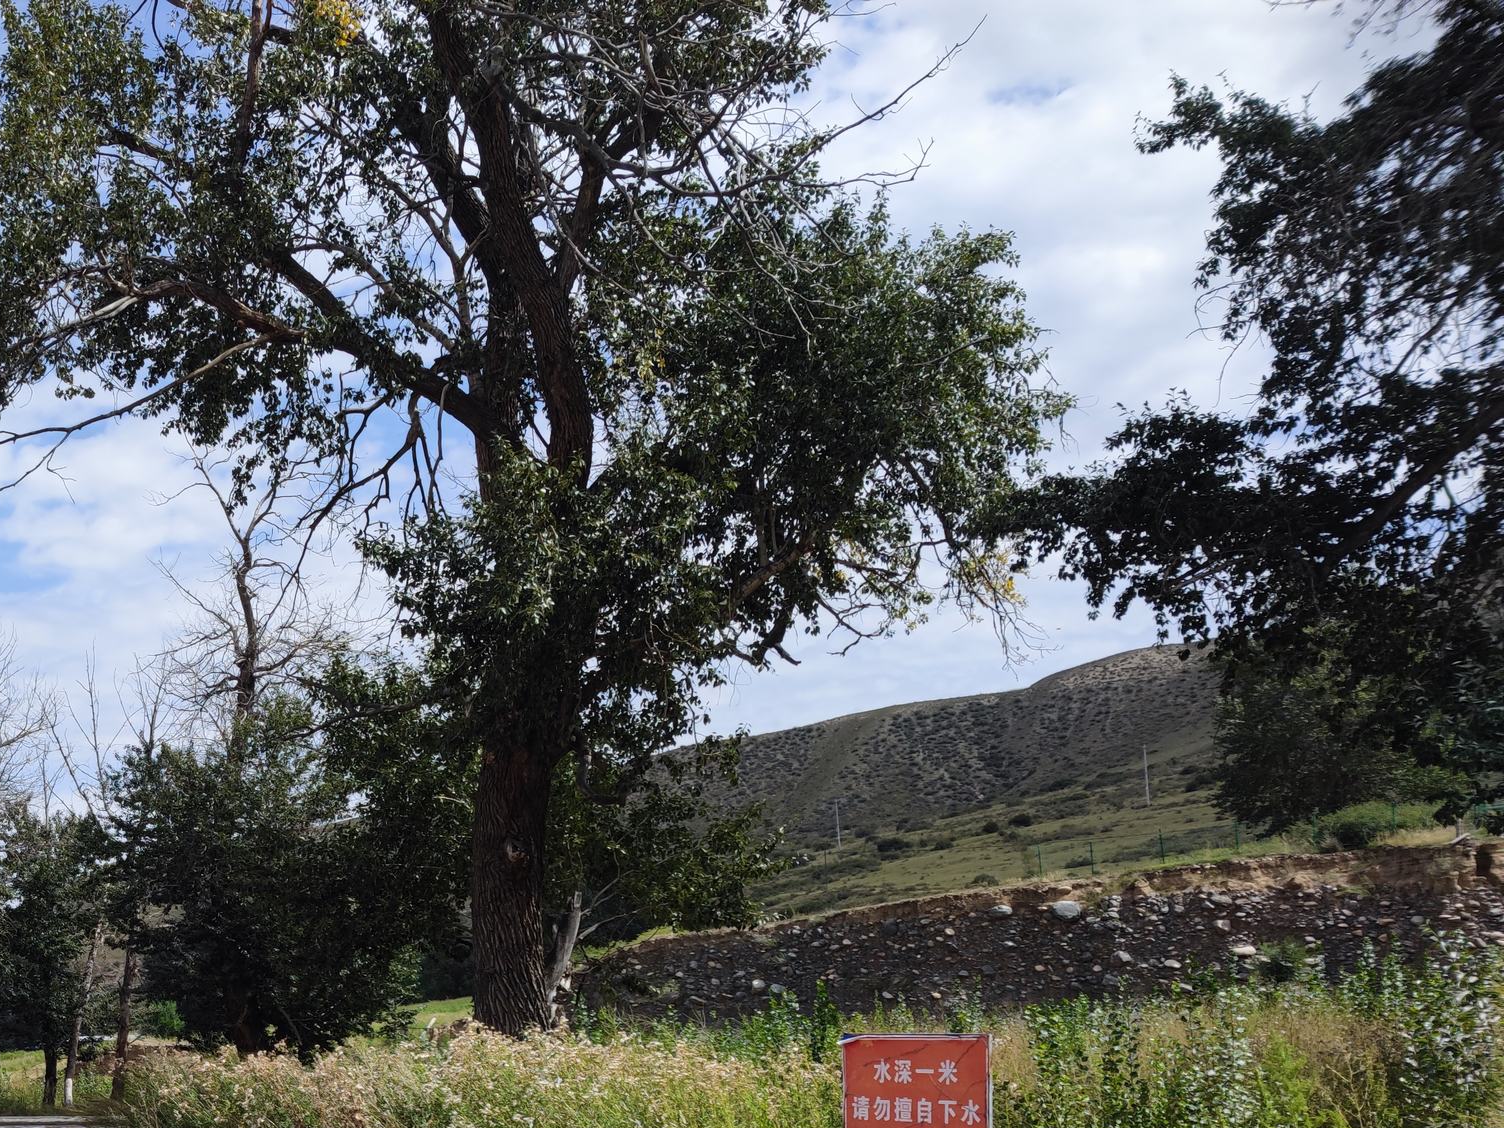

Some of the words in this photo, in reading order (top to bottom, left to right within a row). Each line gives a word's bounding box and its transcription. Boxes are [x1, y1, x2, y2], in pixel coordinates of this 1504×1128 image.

[873, 1058, 958, 1085] 水深一米
[851, 1096, 982, 1126] 请勿擅自下水
